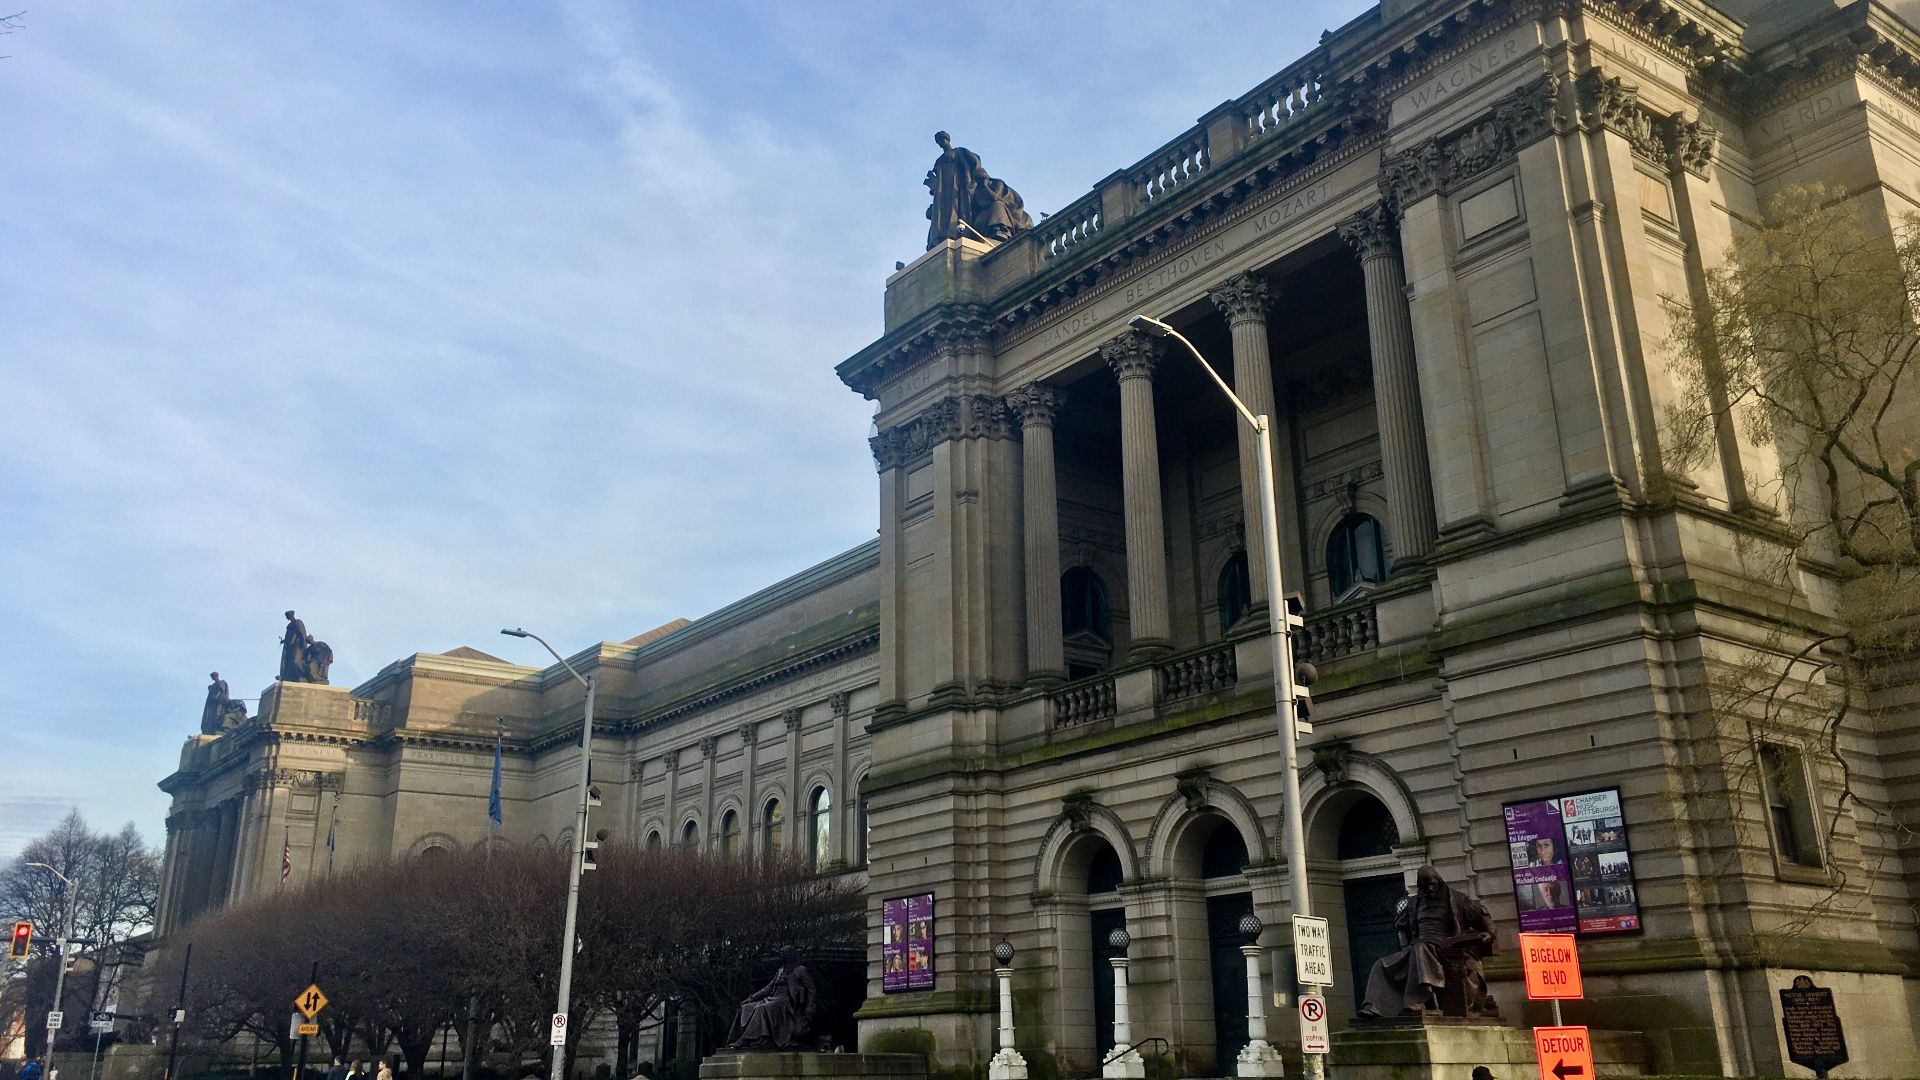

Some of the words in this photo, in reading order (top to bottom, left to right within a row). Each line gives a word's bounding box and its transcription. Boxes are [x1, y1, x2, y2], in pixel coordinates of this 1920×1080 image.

[1612, 37, 1660, 77] LISZT
[1411, 39, 1517, 110] WAGNER
[1760, 91, 1844, 137] VERDI
[1879, 97, 1918, 132] BERLI
[1043, 309, 1099, 351] HANDEL
[1126, 237, 1226, 303] BEETHOVEN
[1254, 182, 1331, 235] MOZART
[1576, 794, 1607, 803] CHAMBER
[1577, 801, 1597, 810] MUSIC
[1578, 805, 1619, 816] PITTSBURGH
[1297, 925, 1311, 938] TWO
[1312, 926, 1325, 939] WAY
[1300, 943, 1326, 958] TRAFFIC
[1530, 948, 1571, 963] BIGELOW
[1304, 962, 1326, 976] AHEAD
[1542, 970, 1567, 985] BLVD
[1542, 1037, 1585, 1054] DETOUR
